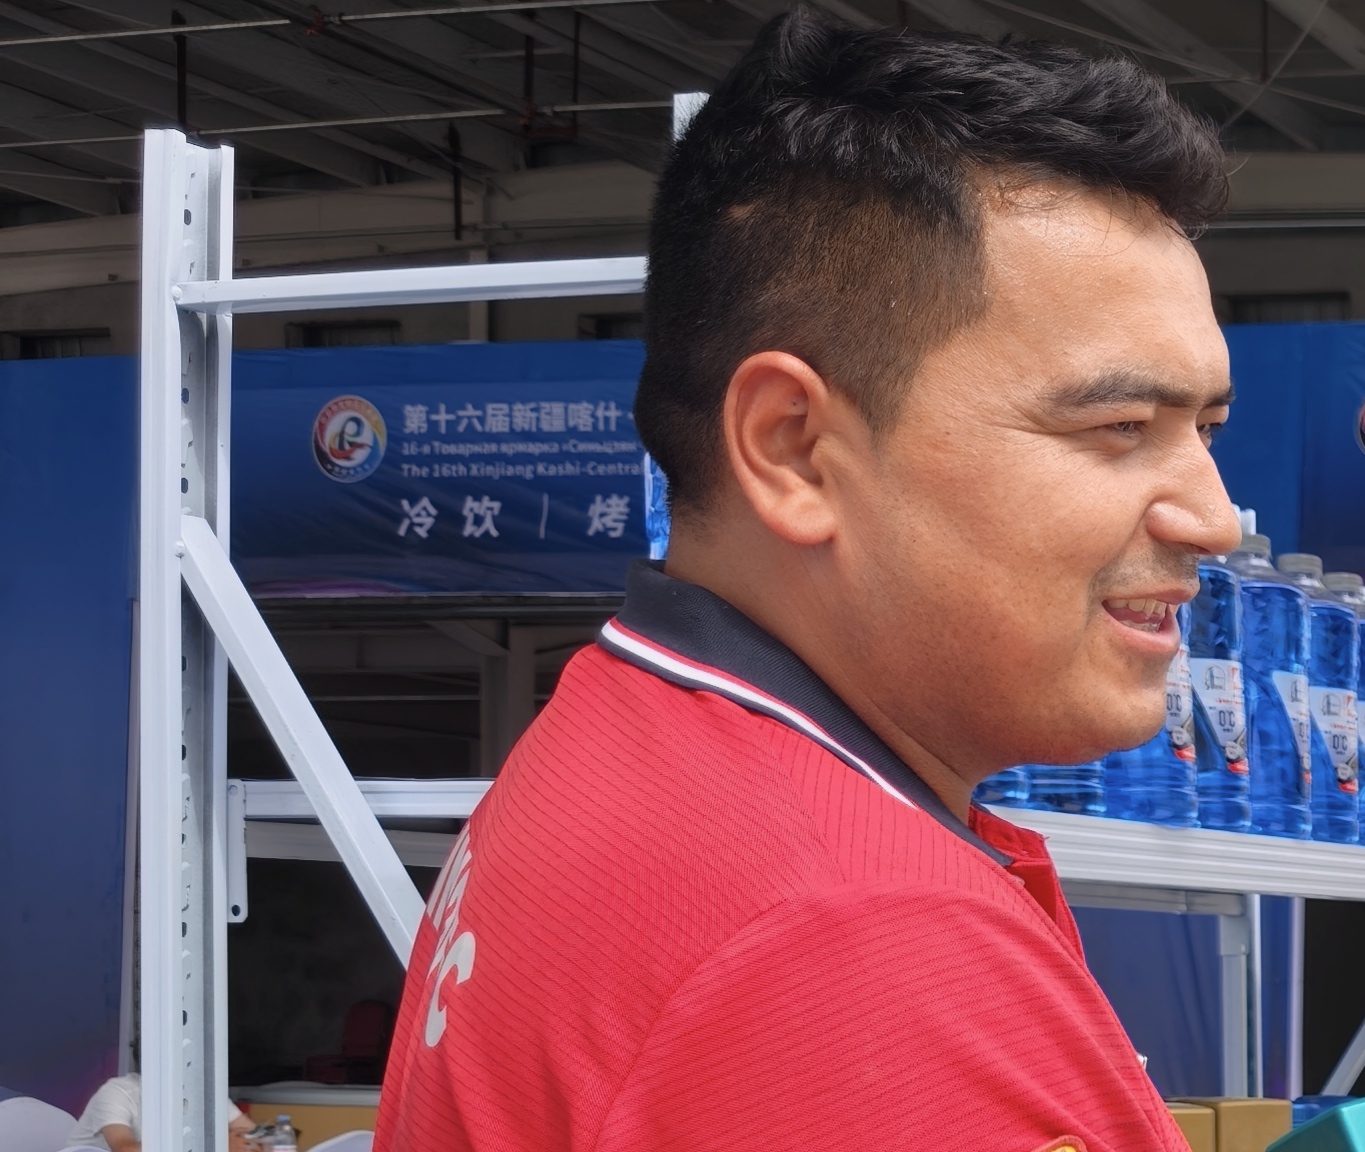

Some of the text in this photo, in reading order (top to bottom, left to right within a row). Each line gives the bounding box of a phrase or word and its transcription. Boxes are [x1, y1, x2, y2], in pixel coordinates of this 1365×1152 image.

[401, 463, 429, 478] The
[433, 462, 467, 478] 16th
[470, 461, 534, 480] Xinjiang
